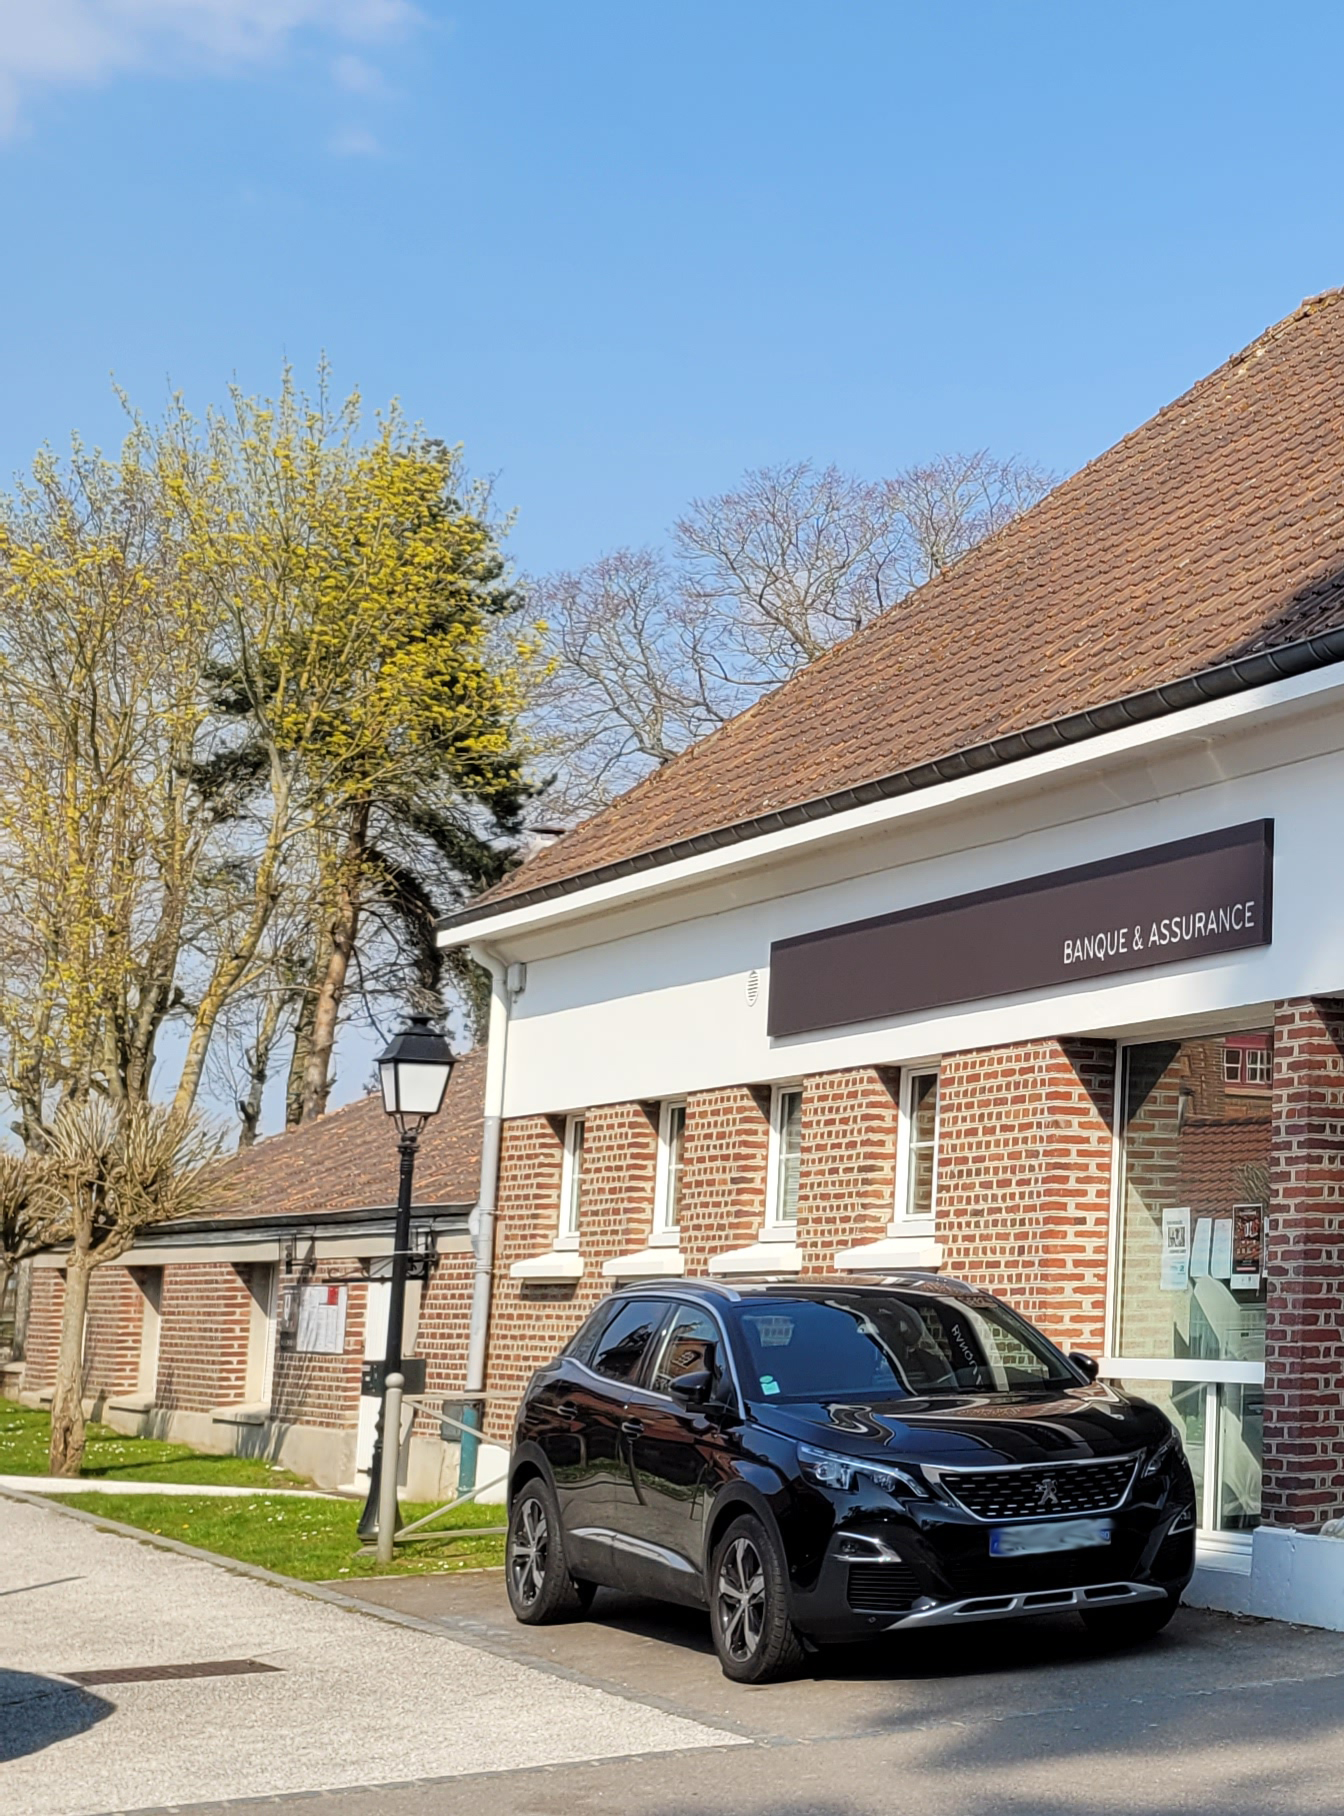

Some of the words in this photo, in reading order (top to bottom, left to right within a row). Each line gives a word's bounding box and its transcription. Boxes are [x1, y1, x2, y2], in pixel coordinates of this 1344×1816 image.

[1063, 928, 1128, 964] BANQUE
[1133, 925, 1144, 950] &
[1148, 901, 1255, 948] ASSURANCE
